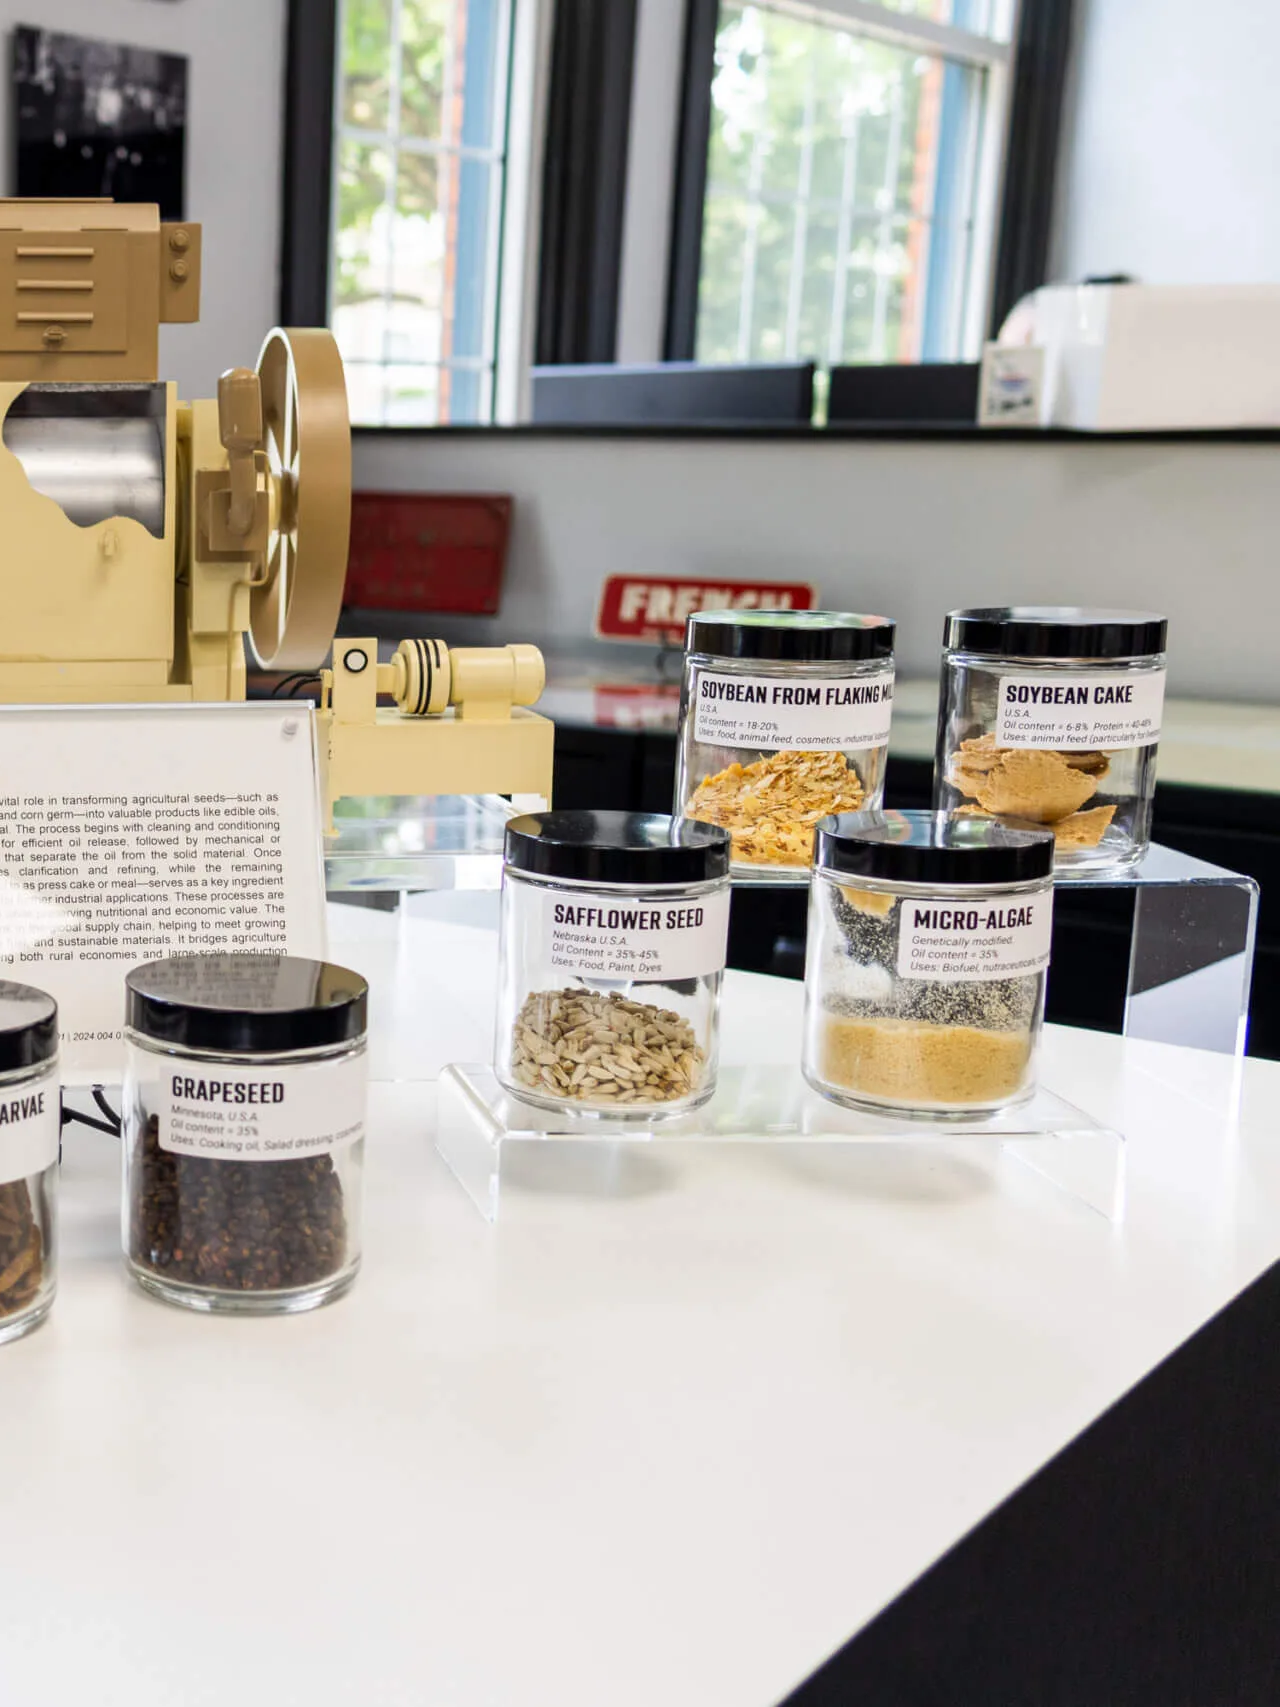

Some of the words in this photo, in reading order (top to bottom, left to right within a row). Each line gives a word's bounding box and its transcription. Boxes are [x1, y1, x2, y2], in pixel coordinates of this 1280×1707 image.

[702, 681, 767, 704] SOYBEAN
[772, 688, 820, 705] FROM
[826, 686, 879, 706] FLAKING
[1007, 685, 1089, 704] SOYBEAN
[1094, 685, 1133, 704] CAKE
[699, 716, 708, 724] Oil
[708, 718, 737, 728] content
[747, 721, 778, 731] 18-20%
[1004, 721, 1016, 729] Oil
[1018, 722, 1054, 731] content
[1067, 723, 1089, 731] 6-8%
[1094, 722, 1123, 731] Protein
[739, 733, 769, 742] animal
[772, 734, 793, 744] feed,
[1031, 734, 1064, 743] animal
[1067, 734, 1087, 743] feed
[0, 796, 19, 806] vital
[24, 795, 44, 806] role
[49, 795, 57, 806] in
[62, 794, 127, 808] transforming
[132, 793, 189, 806] agricultural
[266, 794, 278, 802] as
[20, 812, 44, 820] corn
[108, 808, 152, 819] valuable
[155, 807, 200, 820] products
[204, 806, 221, 817] like
[224, 806, 255, 817] edible
[258, 805, 279, 818] oils,
[1, 837, 15, 848] for
[22, 837, 62, 848] efficient
[69, 836, 80, 847] oil
[88, 835, 129, 849] release,
[136, 835, 179, 846] followed
[186, 834, 198, 847] by
[205, 833, 264, 845] mechanical
[271, 835, 280, 843] or
[554, 904, 661, 930] SAFFLOWER
[667, 908, 703, 929] SEED
[914, 906, 1033, 930] MICRO-ALGAE
[85, 920, 119, 934] supply
[123, 919, 155, 933] chain,
[159, 918, 197, 932] helping
[201, 918, 211, 930] to
[215, 918, 241, 929] meet
[245, 917, 285, 931] growing
[34, 935, 54, 946] and
[58, 934, 118, 946] sustainable
[122, 933, 173, 945] materials.
[178, 933, 184, 944] It
[188, 932, 228, 946] bridges
[232, 931, 286, 945] agriculture
[553, 930, 597, 944] Nebraska
[912, 935, 968, 948] Genetically
[553, 942, 564, 953] Oil
[567, 945, 604, 957] Content
[616, 949, 659, 959] 35%-45%
[911, 949, 925, 958] Oil
[928, 949, 968, 960] content
[979, 950, 999, 959] 35%
[638, 963, 662, 974] Dyes
[942, 963, 980, 974] Biofuel,
[172, 1076, 284, 1103] GRAPESEED
[171, 1105, 224, 1121] Minnesota,
[170, 1119, 183, 1129] Oil
[185, 1122, 224, 1135] content
[236, 1126, 259, 1136] 35%
[199, 1138, 242, 1152] Cooking
[264, 1138, 293, 1150] Salad
[296, 1133, 333, 1149] dressing
